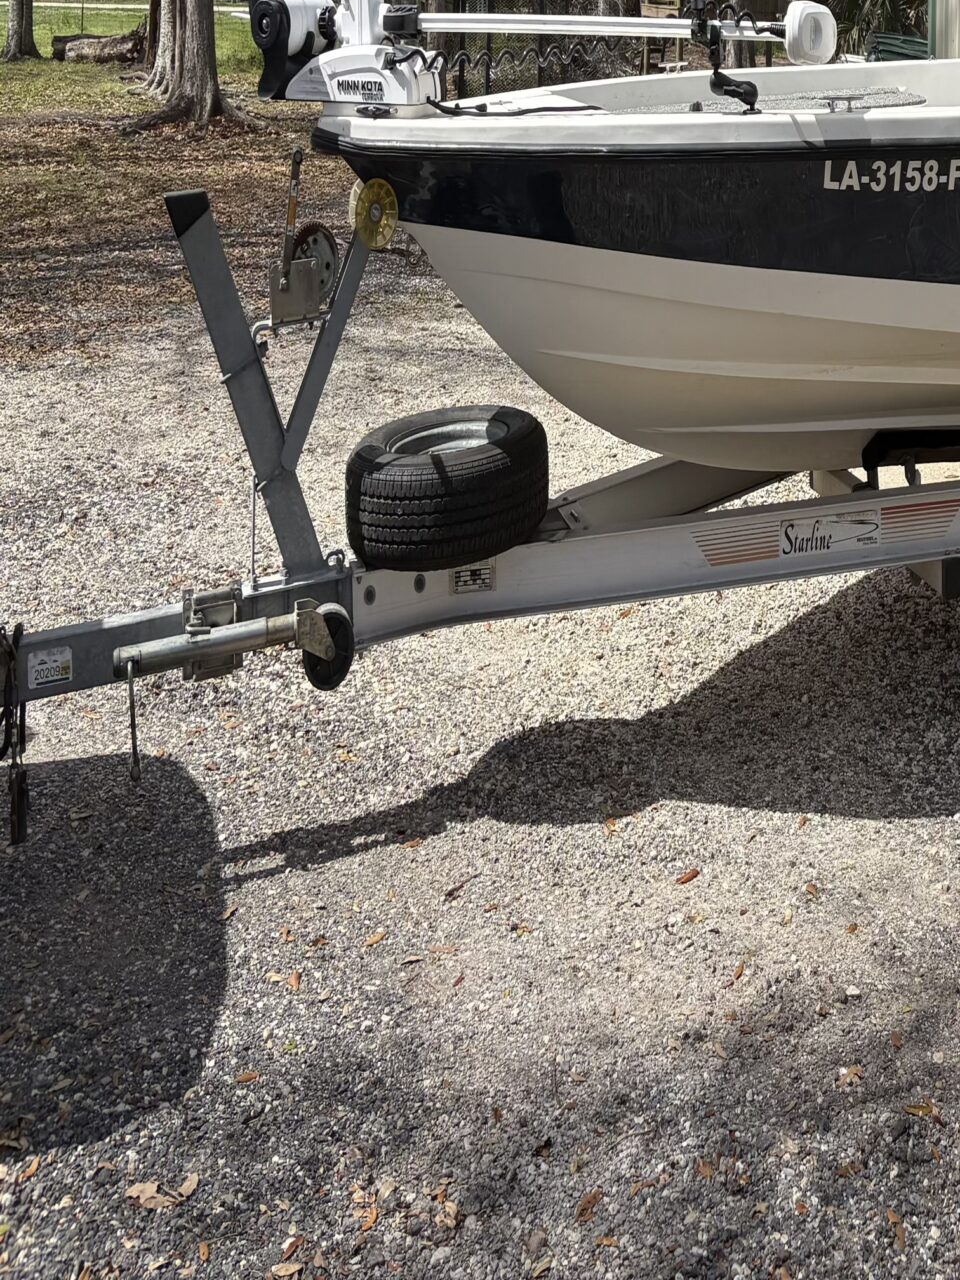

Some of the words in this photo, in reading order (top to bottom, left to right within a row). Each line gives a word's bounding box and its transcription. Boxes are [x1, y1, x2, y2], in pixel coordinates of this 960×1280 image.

[337, 79, 360, 95] MINN
[361, 80, 384, 94] KOTA
[782, 519, 832, 555] Starline
